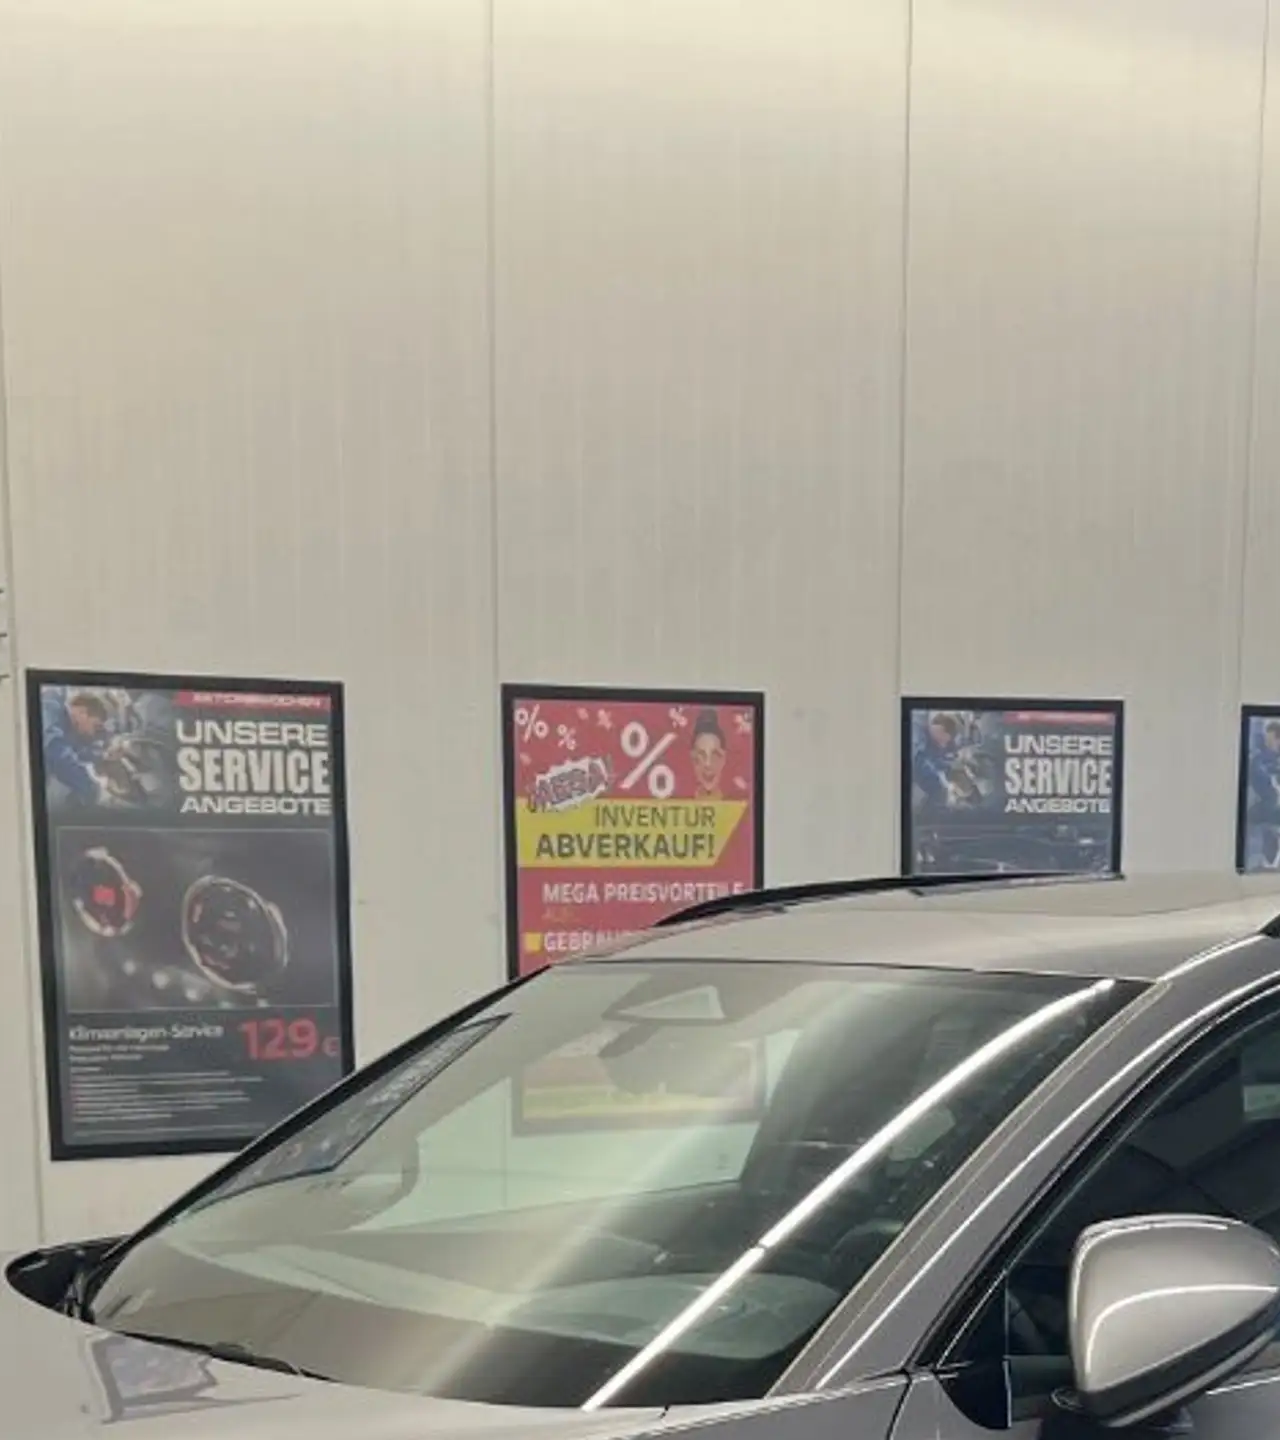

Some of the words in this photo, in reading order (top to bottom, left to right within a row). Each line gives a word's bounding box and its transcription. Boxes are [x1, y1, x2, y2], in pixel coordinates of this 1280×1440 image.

[176, 719, 330, 747] UNSERE
[1004, 735, 1113, 756] UNSERE
[177, 747, 331, 794] SERVICE
[619, 721, 677, 798] %
[1004, 757, 1113, 796] SERVICE
[180, 795, 333, 816] ANGEBOTE
[595, 806, 717, 828] INVENTUR
[1004, 798, 1112, 814] ANGEBOTE
[536, 834, 715, 859] ABVERKAUF!
[542, 883, 600, 904] MEGA
[238, 1018, 319, 1061] 129
